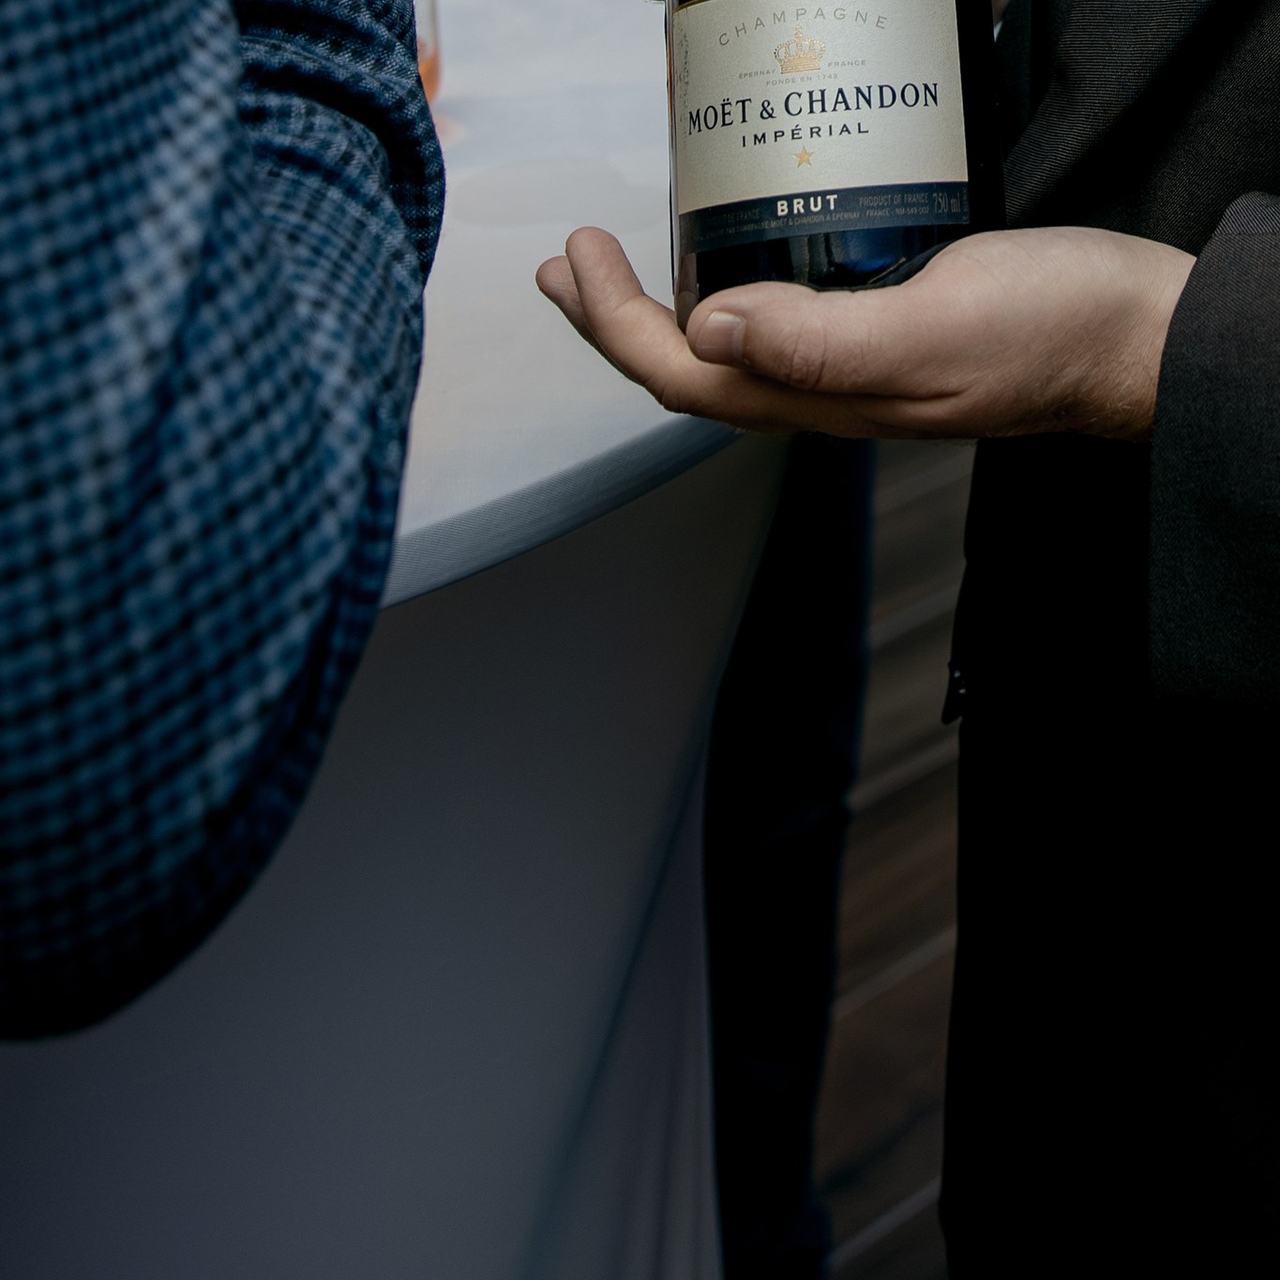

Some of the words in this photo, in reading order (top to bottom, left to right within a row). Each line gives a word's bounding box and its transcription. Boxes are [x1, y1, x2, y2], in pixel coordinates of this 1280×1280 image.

[719, 7, 888, 46] CHAMPAGNE
[827, 59, 866, 68] FRANCE
[688, 97, 753, 135] MOËT
[759, 99, 777, 120] &
[784, 82, 939, 117] CHANDON
[742, 122, 869, 147] IMPÉRIAL
[777, 194, 838, 217] BRUT
[859, 195, 892, 207] PRODUCT
[893, 194, 902, 204] OF
[904, 192, 929, 203] FRANCE
[932, 192, 948, 214] 750
